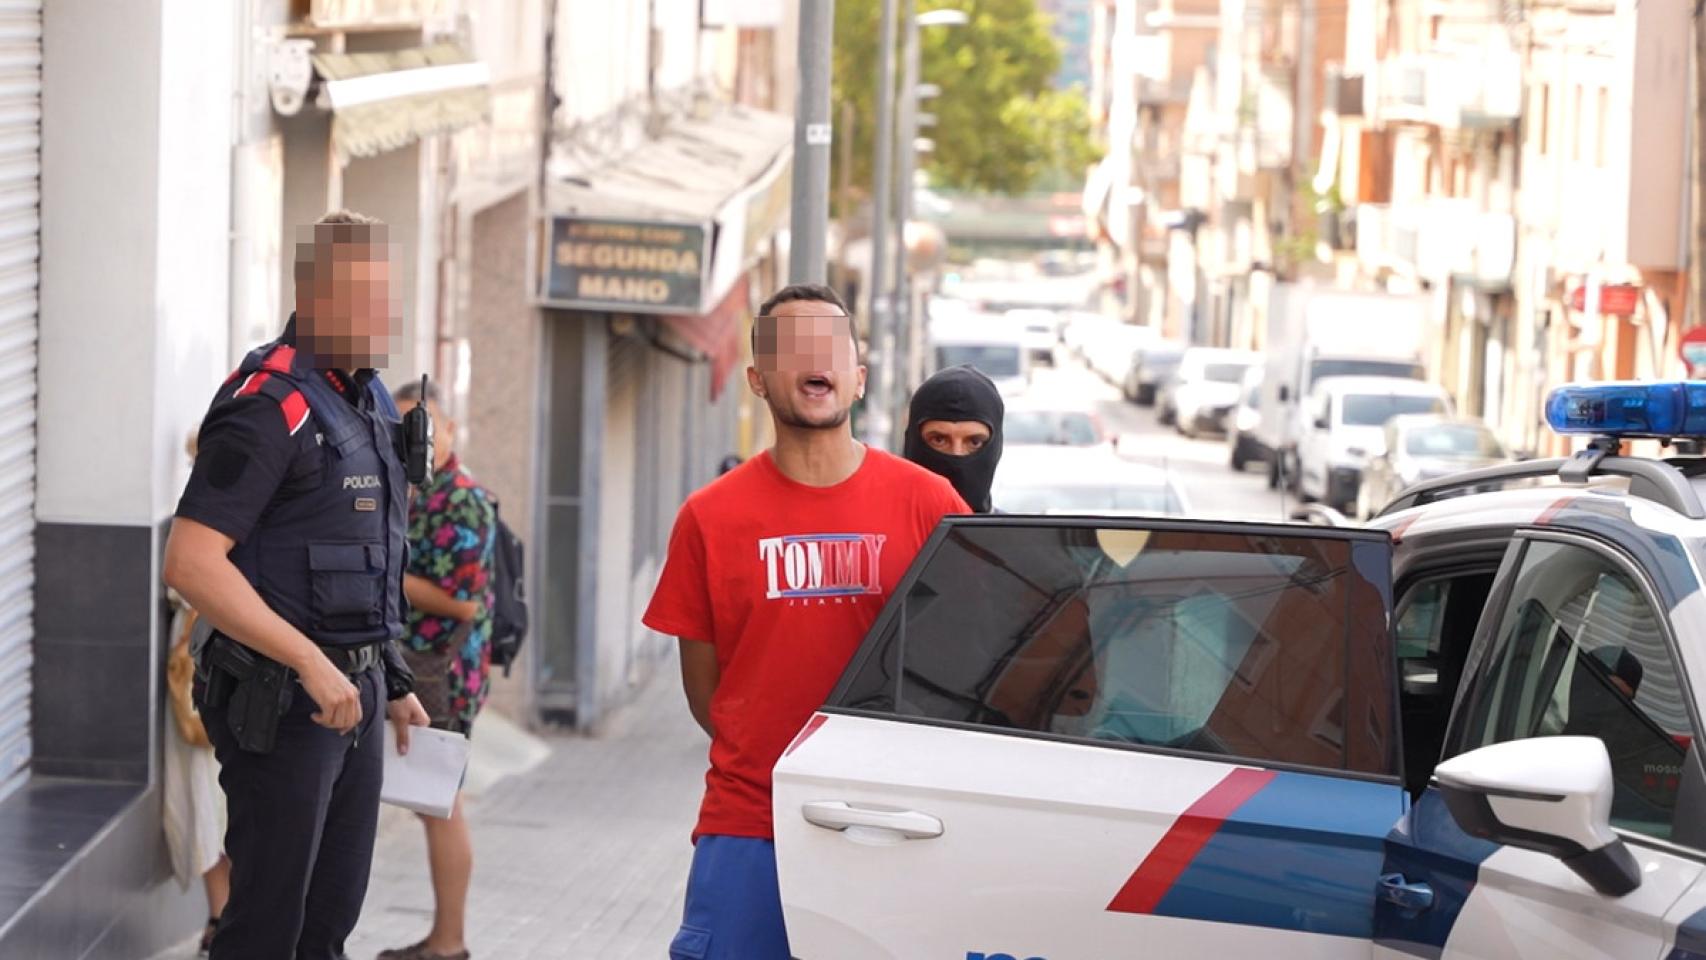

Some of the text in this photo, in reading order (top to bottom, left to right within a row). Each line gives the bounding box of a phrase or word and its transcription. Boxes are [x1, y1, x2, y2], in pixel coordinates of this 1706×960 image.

[556, 242, 698, 275] SEGUNDA
[578, 274, 669, 303] MANO
[759, 534, 886, 599] TOMMY
[789, 596, 857, 606] JEANS
